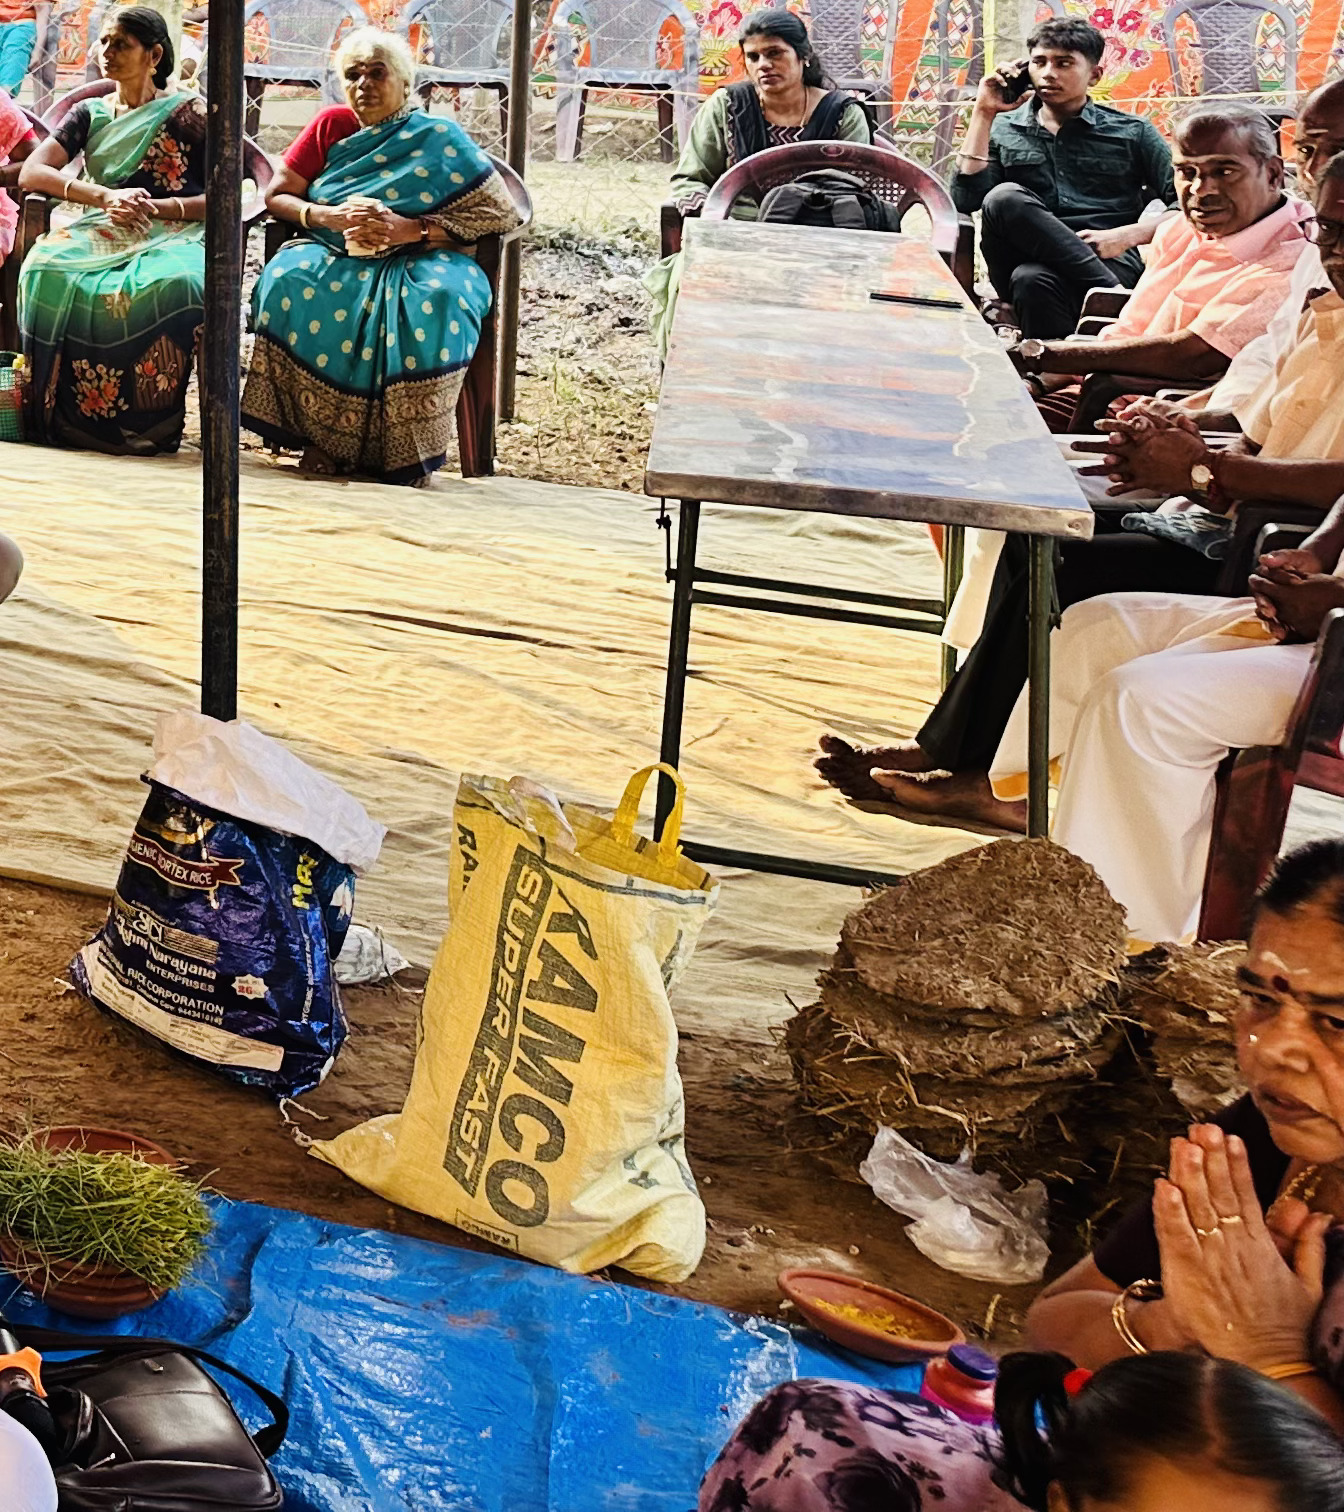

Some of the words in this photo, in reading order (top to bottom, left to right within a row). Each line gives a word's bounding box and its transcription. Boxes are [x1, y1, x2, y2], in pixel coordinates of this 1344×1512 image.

[189, 869, 213, 886] RICE
[148, 942, 217, 980] Narayana
[490, 863, 544, 1039] SUPER
[145, 959, 215, 993] ENTERPRISES
[146, 979, 224, 1016] CORPORATION
[455, 1045, 502, 1180] FAST
